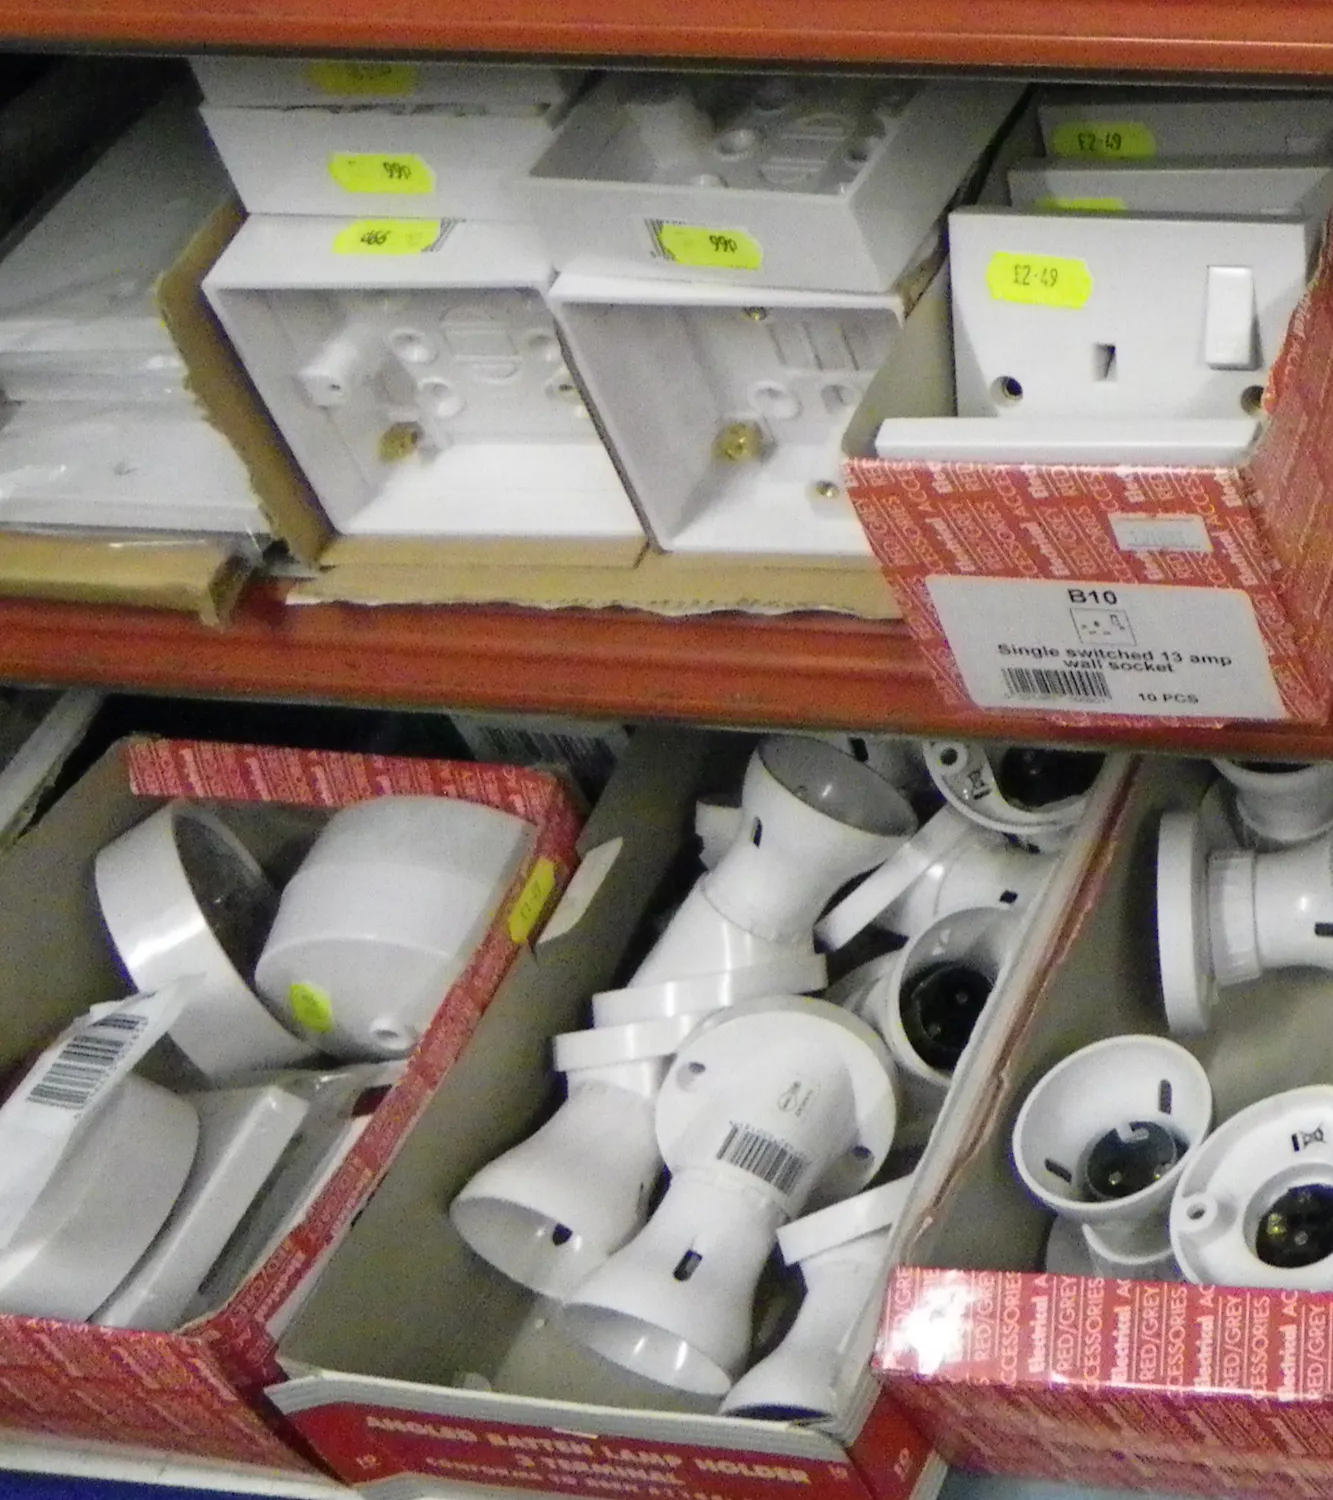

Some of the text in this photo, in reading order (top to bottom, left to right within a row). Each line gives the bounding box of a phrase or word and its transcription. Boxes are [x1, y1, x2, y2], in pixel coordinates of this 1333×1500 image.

[1066, 588, 1118, 606] B10
[996, 643, 1233, 667] Single switched 13 amp
[1063, 658, 1175, 673] wall socket
[1162, 692, 1199, 704] PCS
[1027, 1293, 1049, 1375] Electrical
[1055, 1274, 1079, 1373] RED/GREY
[1110, 1304, 1132, 1386] Electrical
[1138, 1285, 1161, 1383] RED/GREY
[1220, 1293, 1244, 1393] RED/GREY
